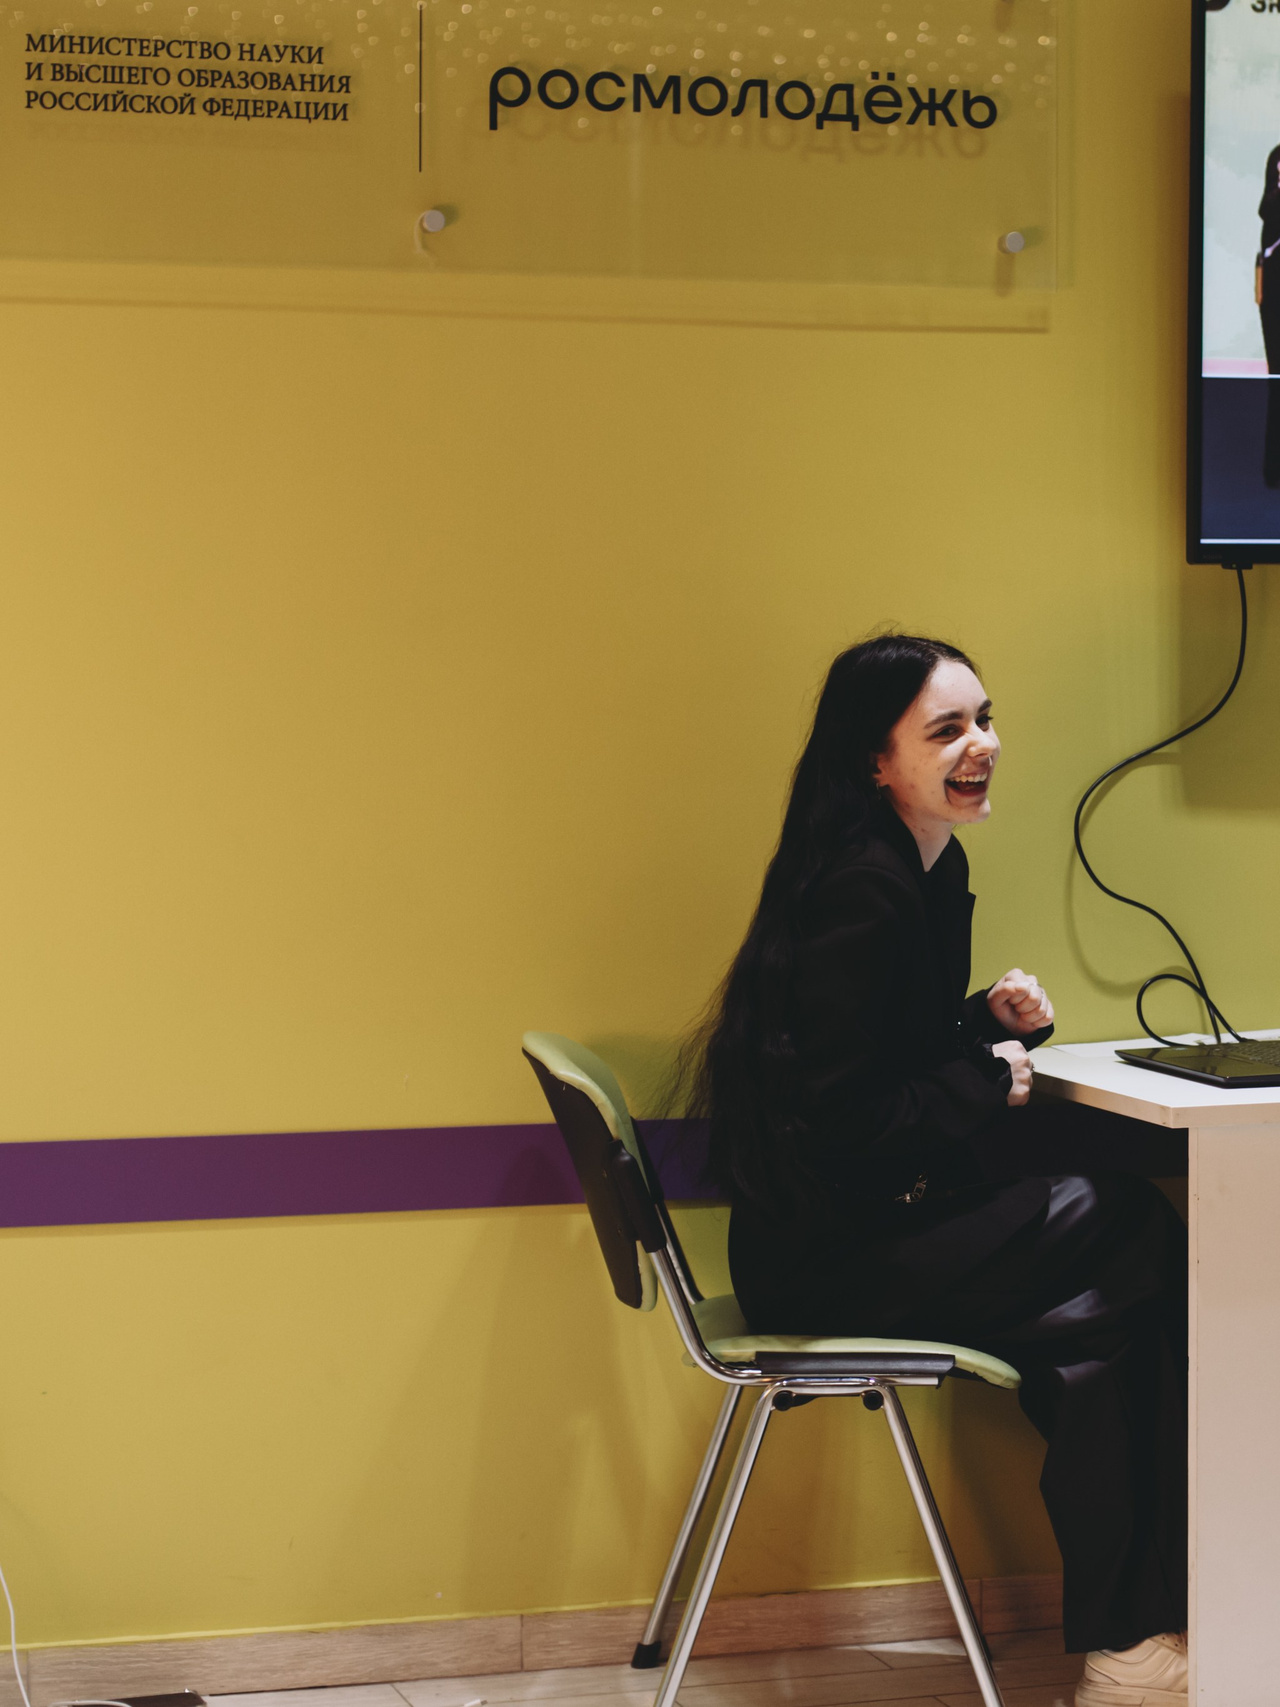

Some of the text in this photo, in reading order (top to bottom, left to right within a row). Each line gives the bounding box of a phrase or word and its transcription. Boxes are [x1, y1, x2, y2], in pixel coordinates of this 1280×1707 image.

[25, 33, 324, 64] МИНИСТЕРСТВО НАУКИ
[25, 62, 352, 94] И ВЫСШЕГО ОБРАЗОВАНИЯ
[25, 90, 350, 124] РОССИЙСКОЙ ФЕДЕРАЦИИ
[489, 66, 998, 131] росмолодёжь
